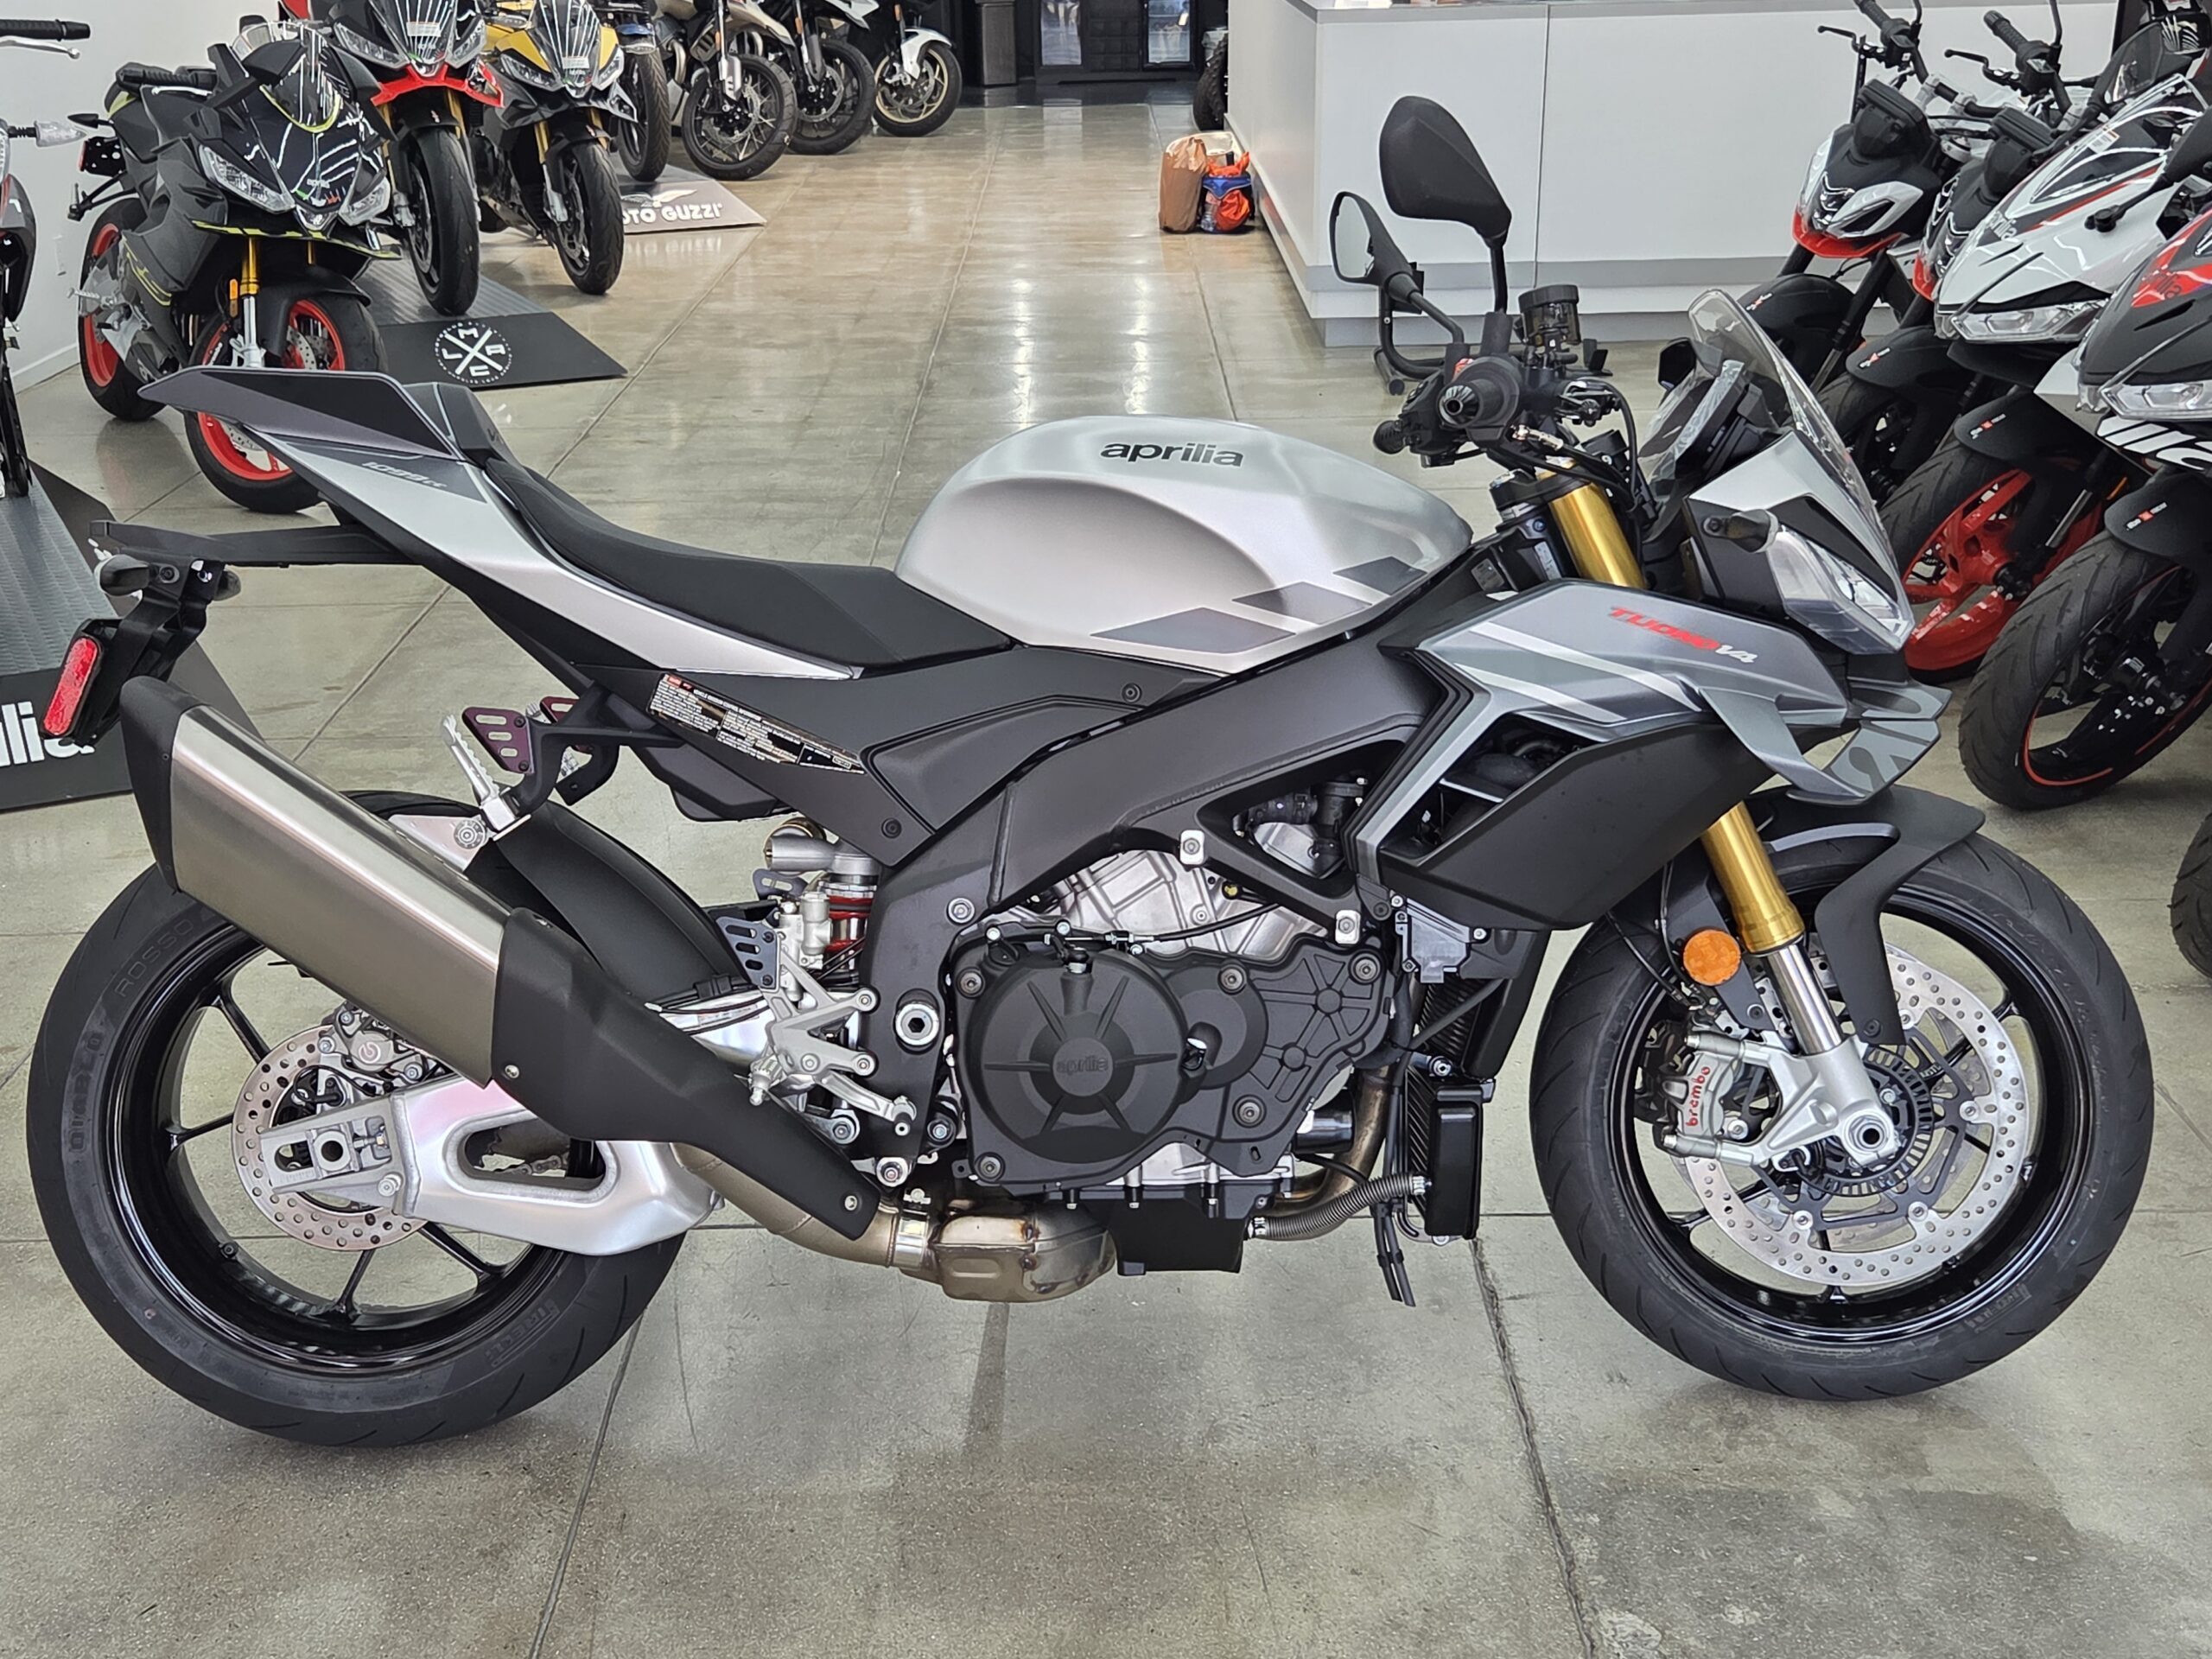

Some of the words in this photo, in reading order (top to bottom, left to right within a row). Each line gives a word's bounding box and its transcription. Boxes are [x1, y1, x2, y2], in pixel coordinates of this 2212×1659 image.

[661, 203, 721, 221] GUZZI
[1100, 442, 1244, 467] aprilia
[1608, 607, 1721, 651] TUONO
[114, 918, 194, 998] ROSSO
[1686, 1066, 1711, 1127] brembo
